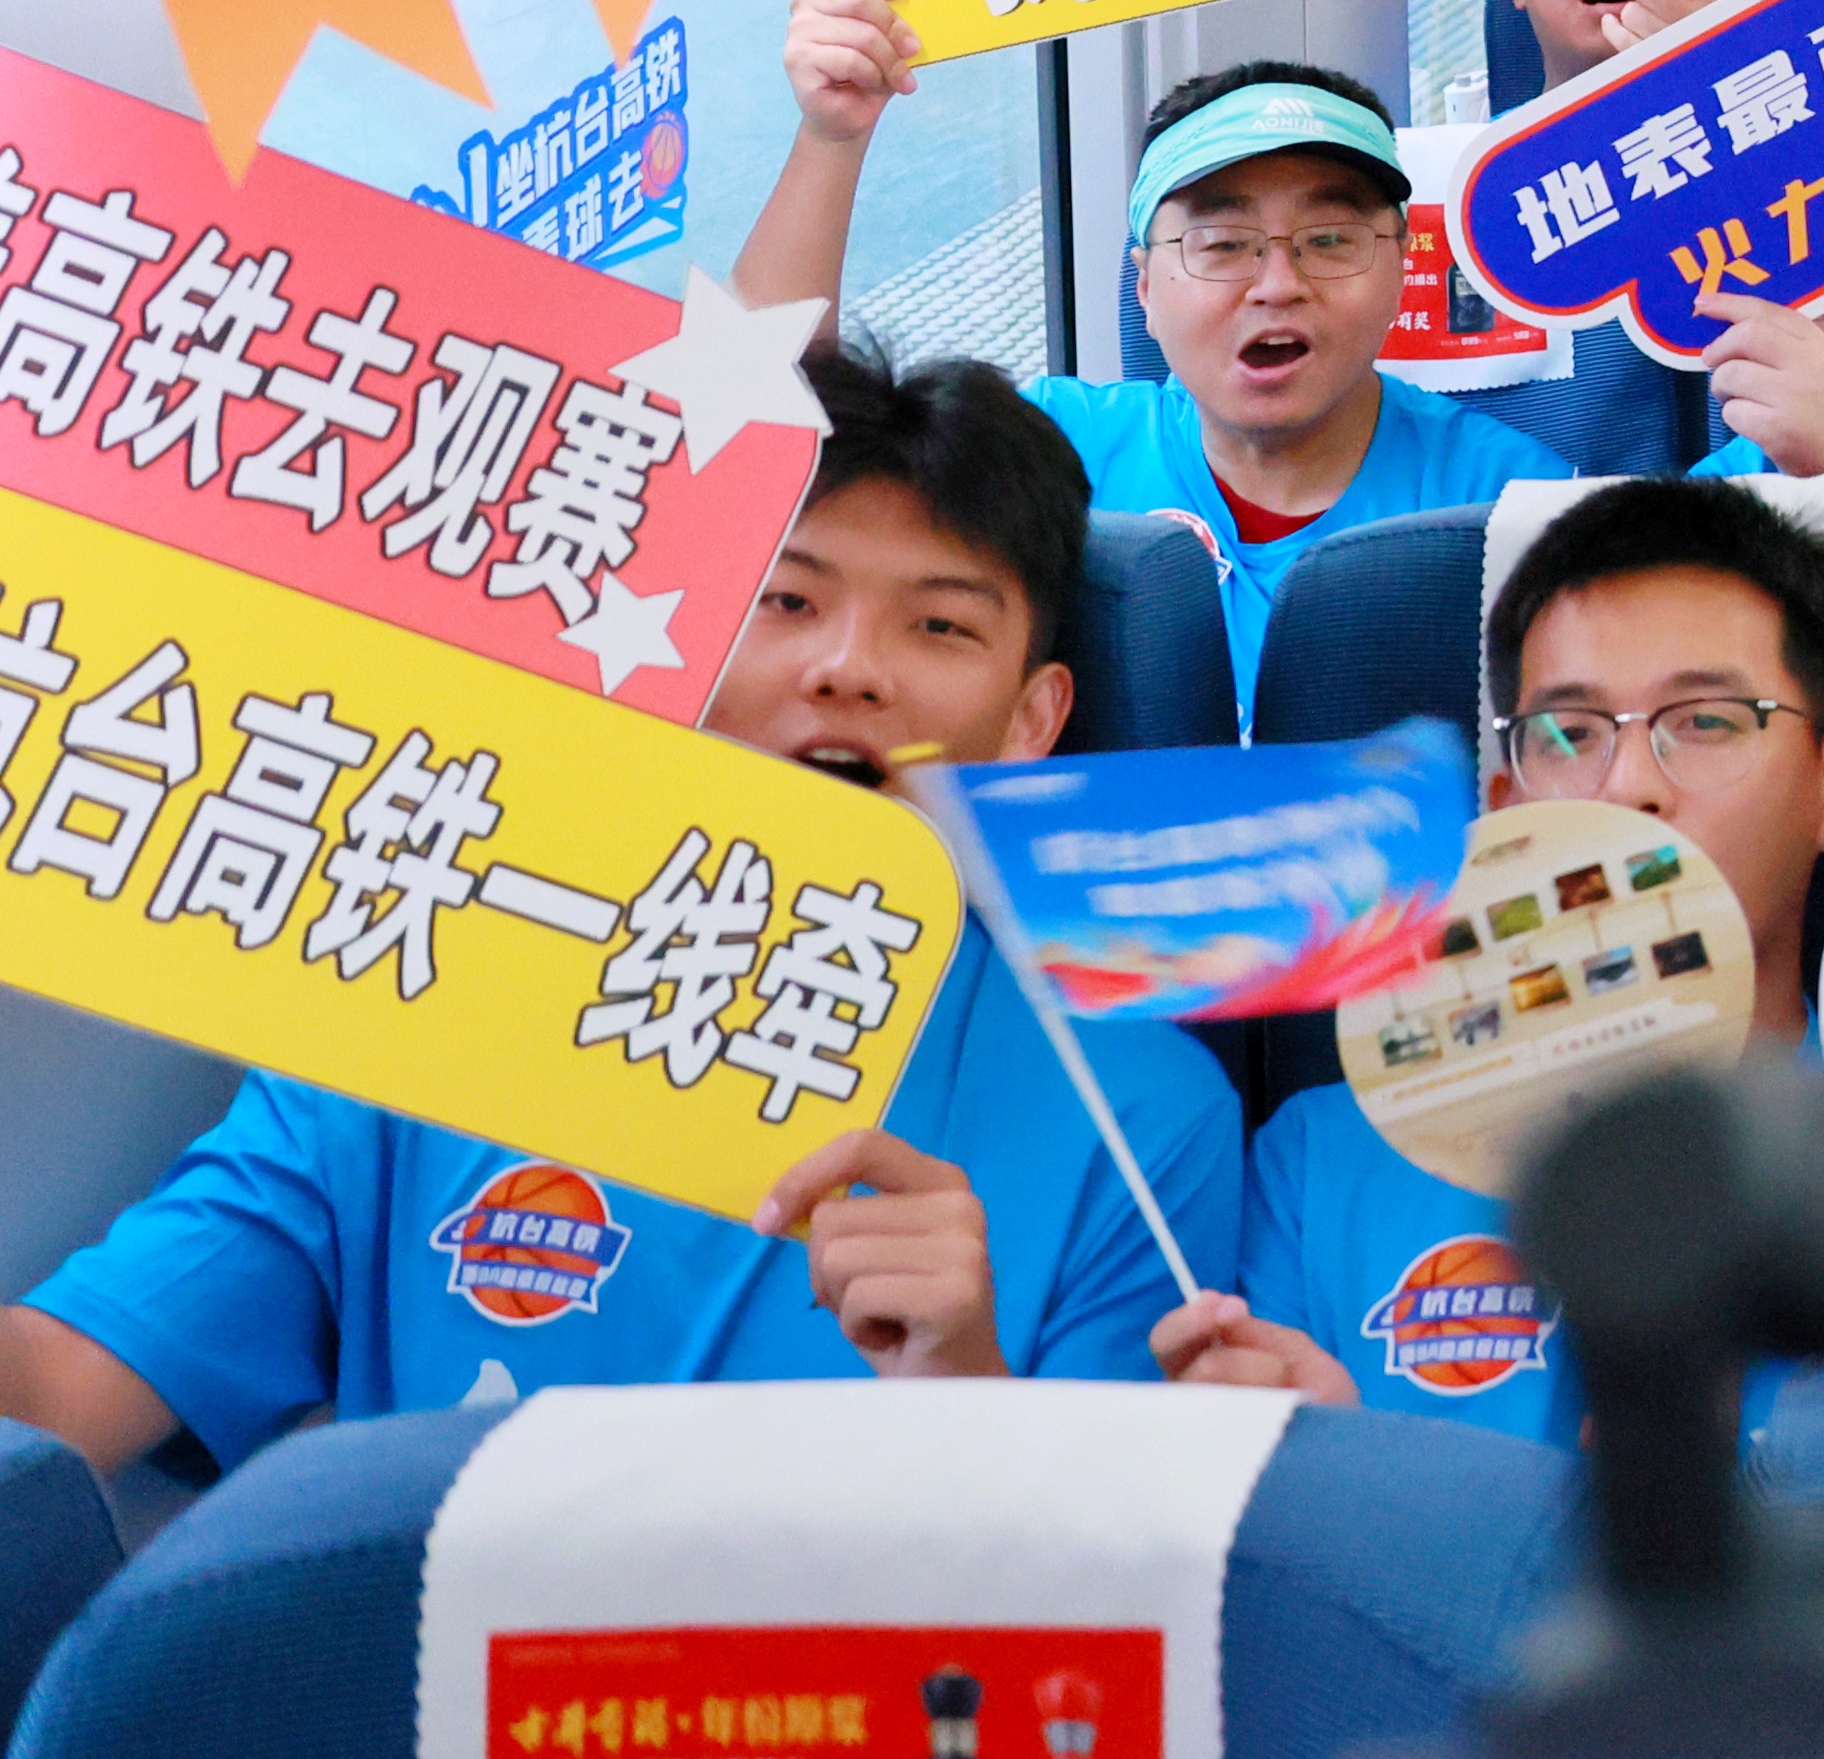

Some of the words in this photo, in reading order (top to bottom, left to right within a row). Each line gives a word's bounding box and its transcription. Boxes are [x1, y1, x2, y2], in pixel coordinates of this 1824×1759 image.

[496, 28, 683, 230] 坐杭台高铁
